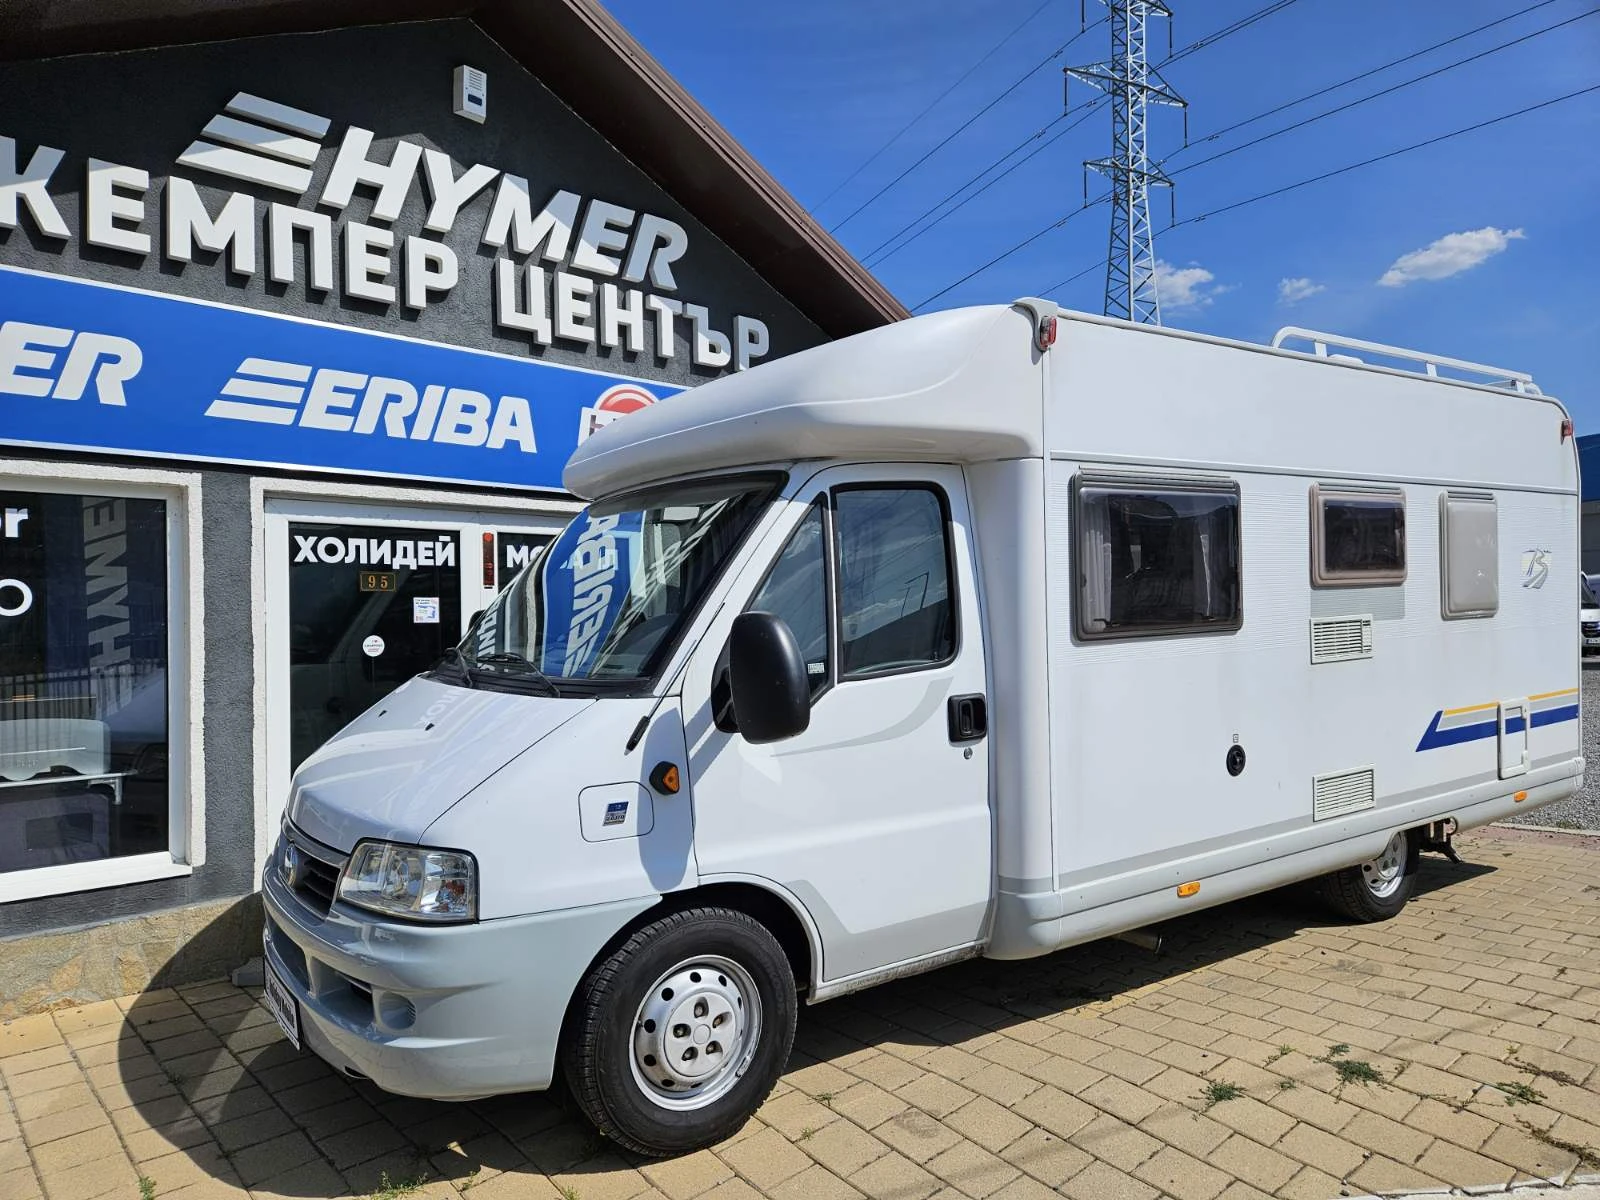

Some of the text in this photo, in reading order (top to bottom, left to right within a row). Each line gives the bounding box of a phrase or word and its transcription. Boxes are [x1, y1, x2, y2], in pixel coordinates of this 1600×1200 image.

[319, 125, 688, 290] HYMER
[0, 135, 769, 371] КЕМПЕР ЦЕНТЪР
[298, 368, 537, 453] ERIBA
[293, 535, 455, 570] ХОЛИДЕЙ
[367, 574, 388, 590] 95
